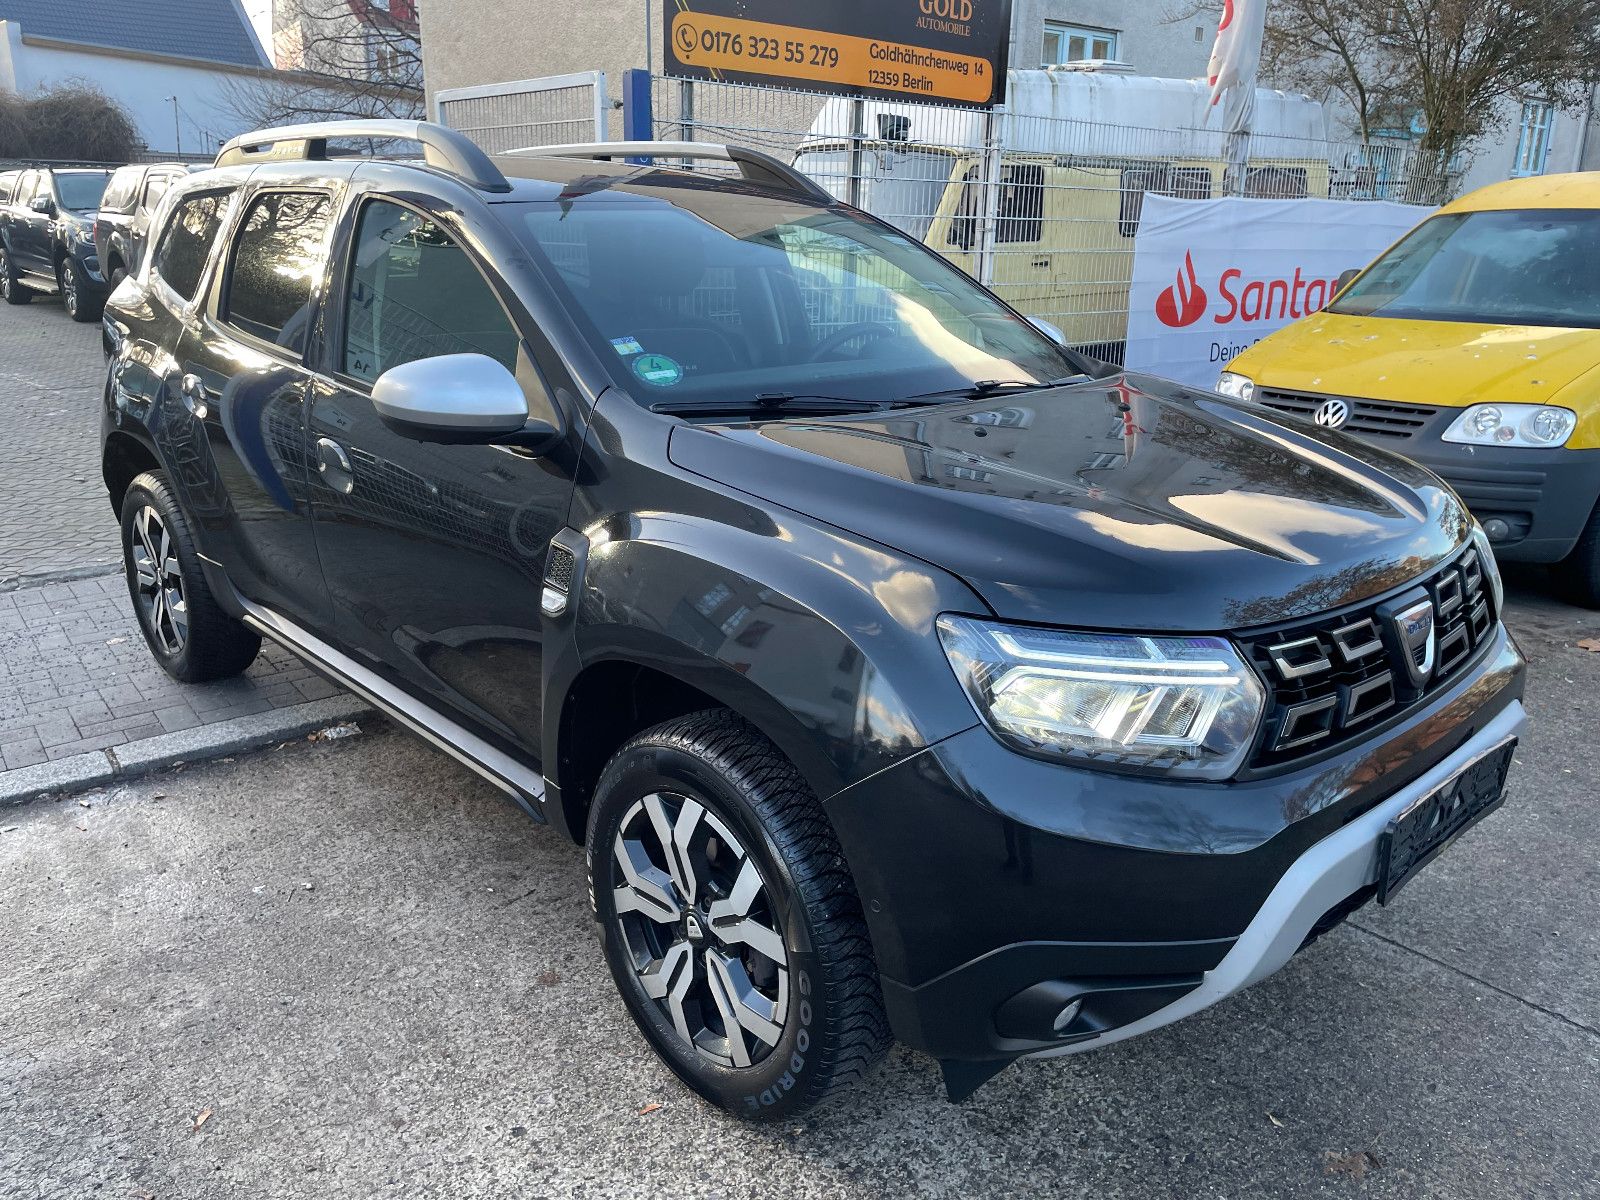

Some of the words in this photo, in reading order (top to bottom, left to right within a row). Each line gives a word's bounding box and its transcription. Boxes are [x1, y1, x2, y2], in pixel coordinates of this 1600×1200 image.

[919, 0, 973, 22] GOLD
[915, 16, 971, 37] AUTOMOBILE
[701, 29, 743, 56] 0176
[748, 36, 780, 60] 323
[784, 41, 805, 63] 55
[809, 44, 839, 68] 279
[869, 43, 969, 75] Goldhähnchenweg
[974, 62, 984, 76] 14
[868, 69, 900, 87] 12359
[902, 73, 934, 91] Berlin
[743, 969, 813, 1110] GOODRIDE
